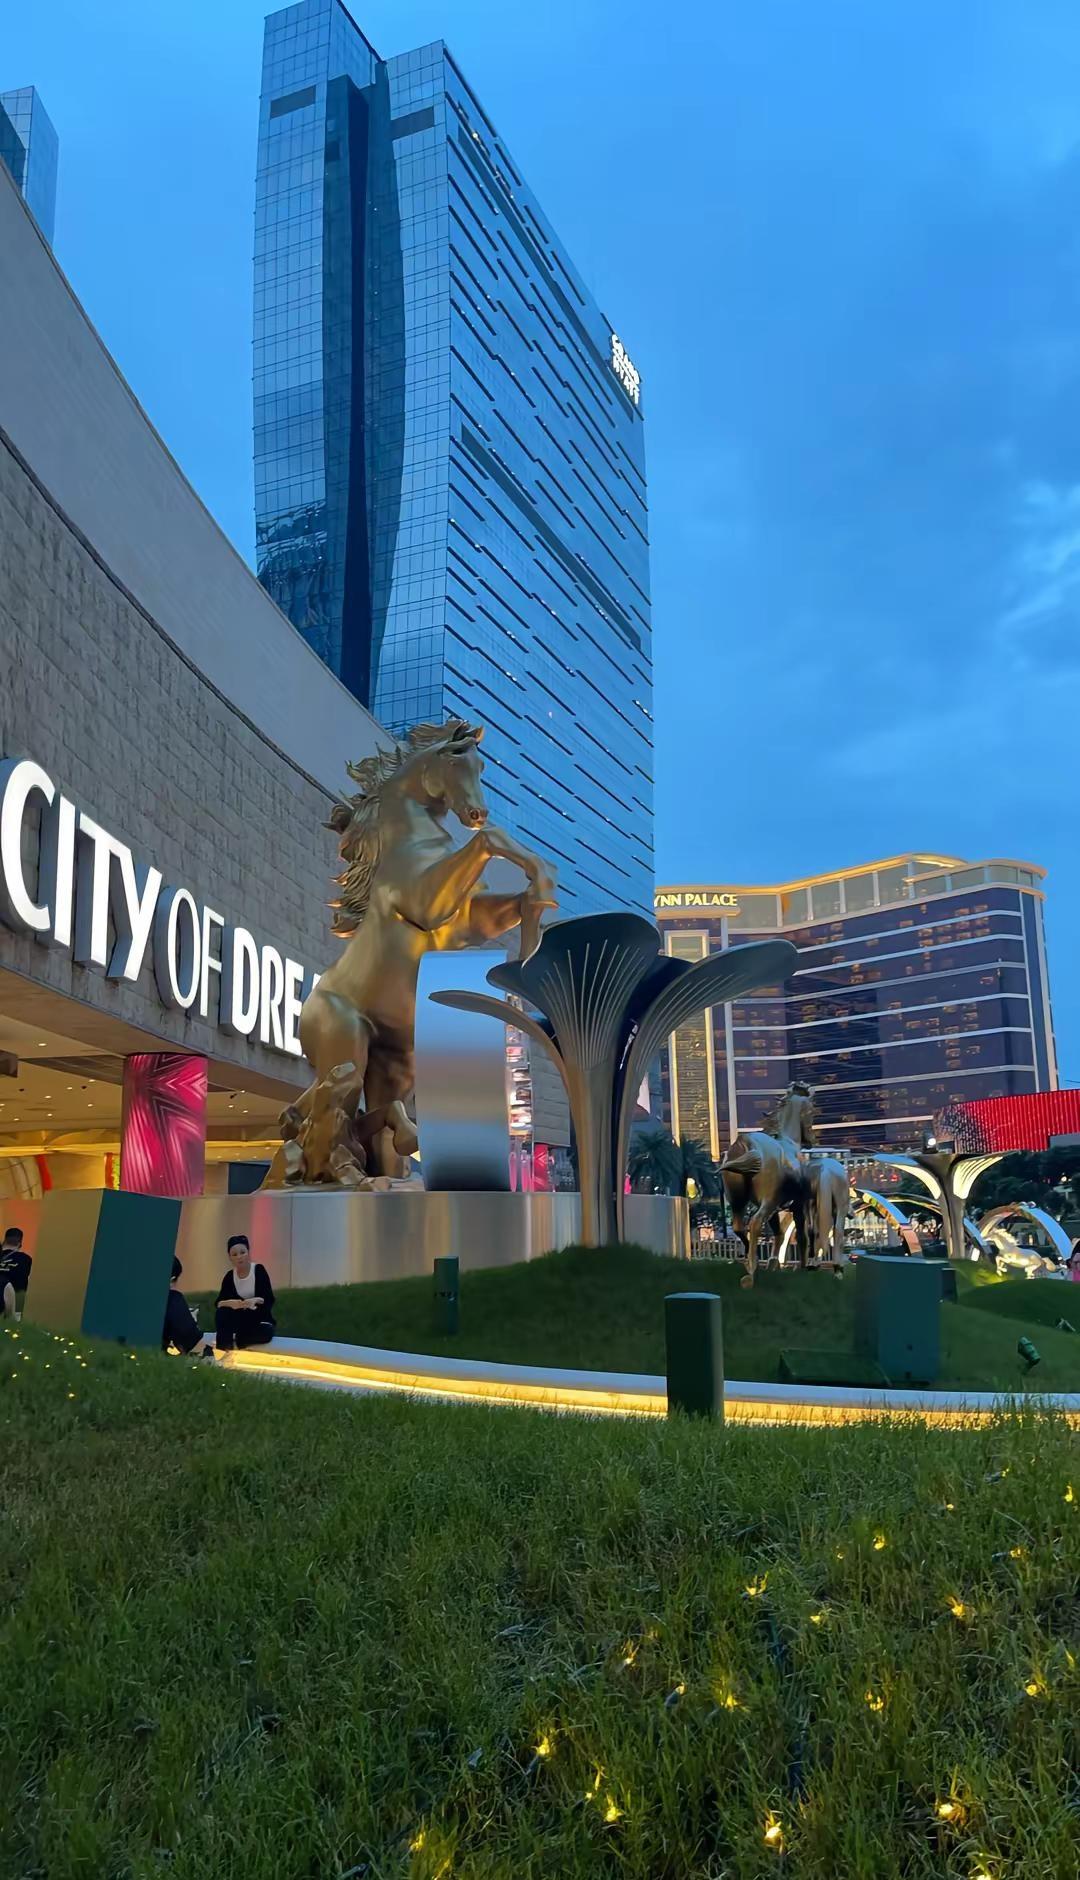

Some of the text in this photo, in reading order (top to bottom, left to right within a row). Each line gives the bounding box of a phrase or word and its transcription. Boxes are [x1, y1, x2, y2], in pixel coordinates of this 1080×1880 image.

[0, 759, 322, 1059] CITY OF DRE
[685, 893, 738, 907] PALACE
